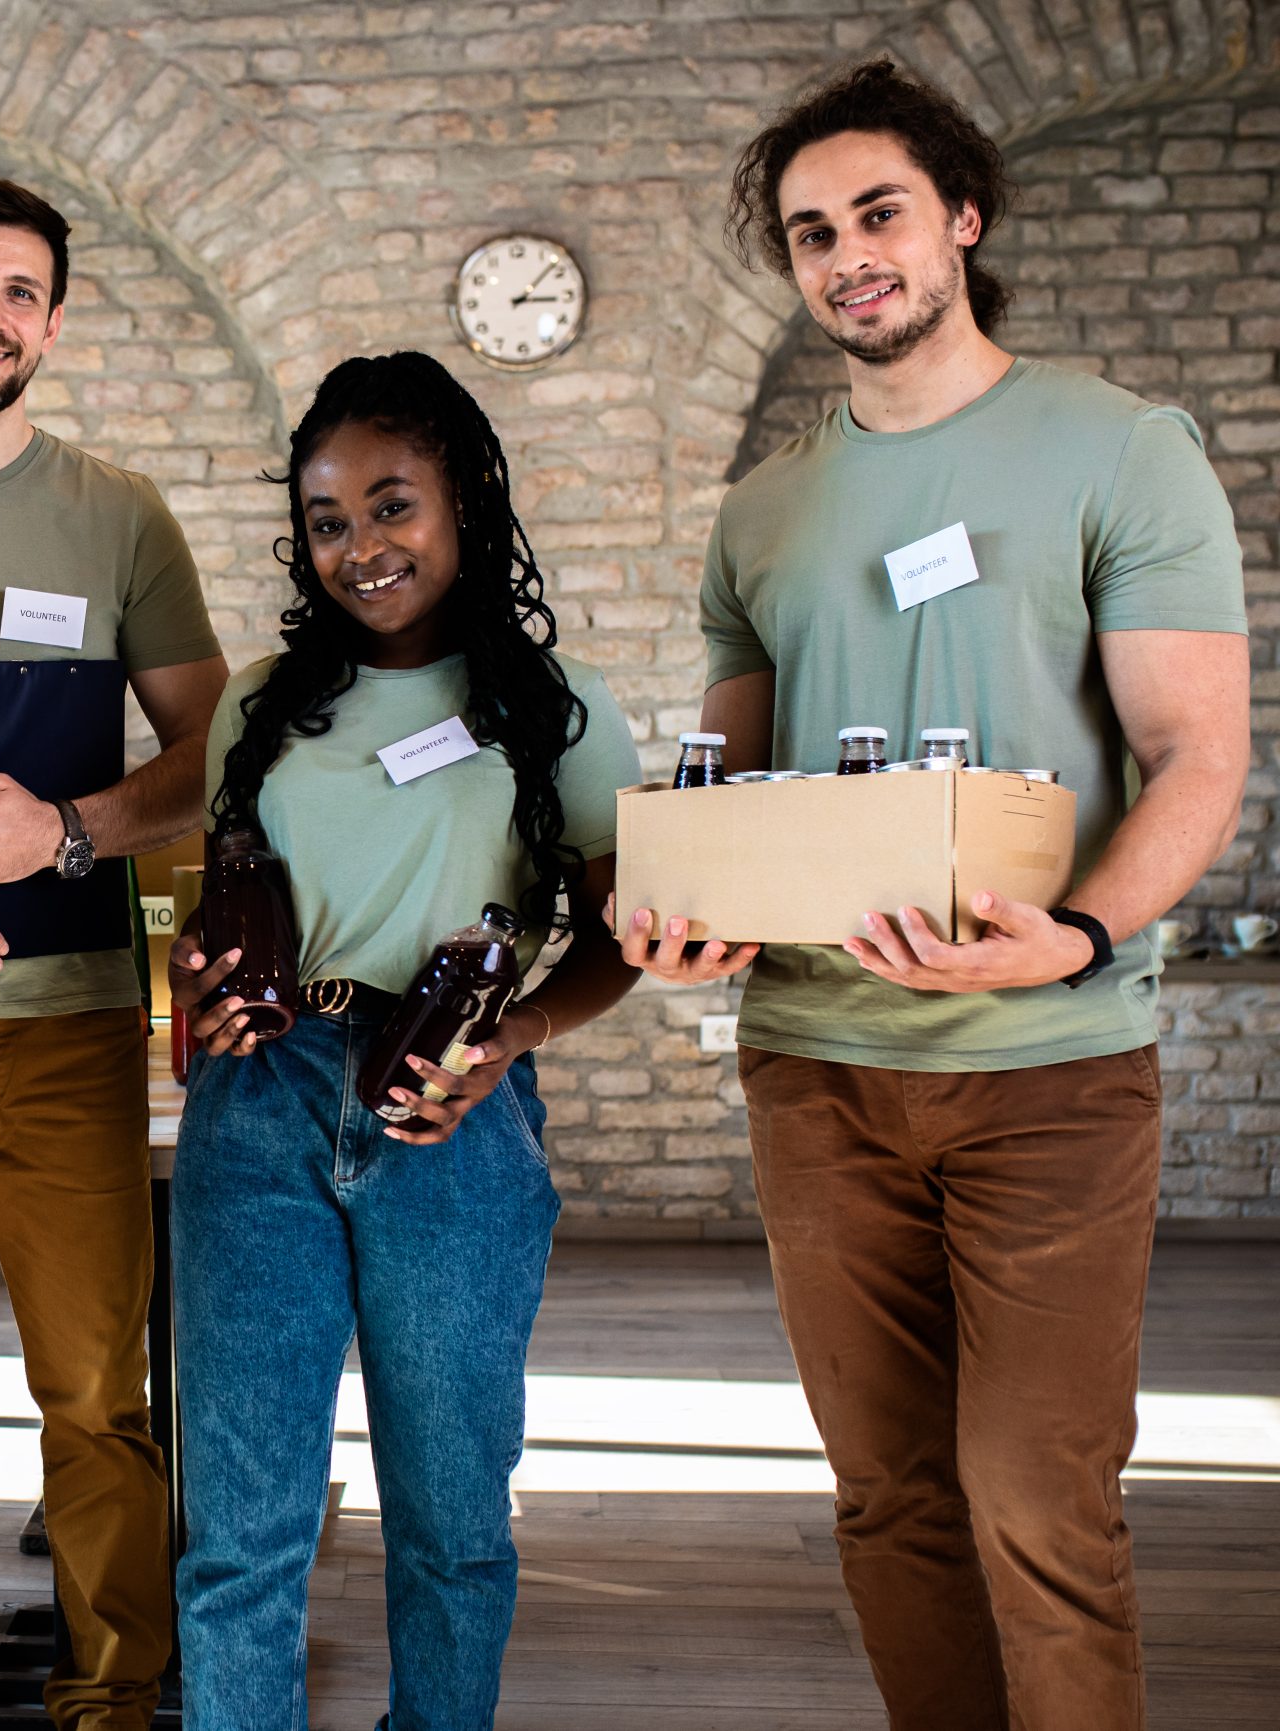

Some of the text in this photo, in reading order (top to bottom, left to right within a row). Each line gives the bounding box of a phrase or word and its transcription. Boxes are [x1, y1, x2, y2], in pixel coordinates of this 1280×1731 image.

[900, 556, 949, 581] VOLUNTEER
[20, 609, 67, 623] VOLUNTEER
[399, 736, 450, 760] VOLUNTEER
